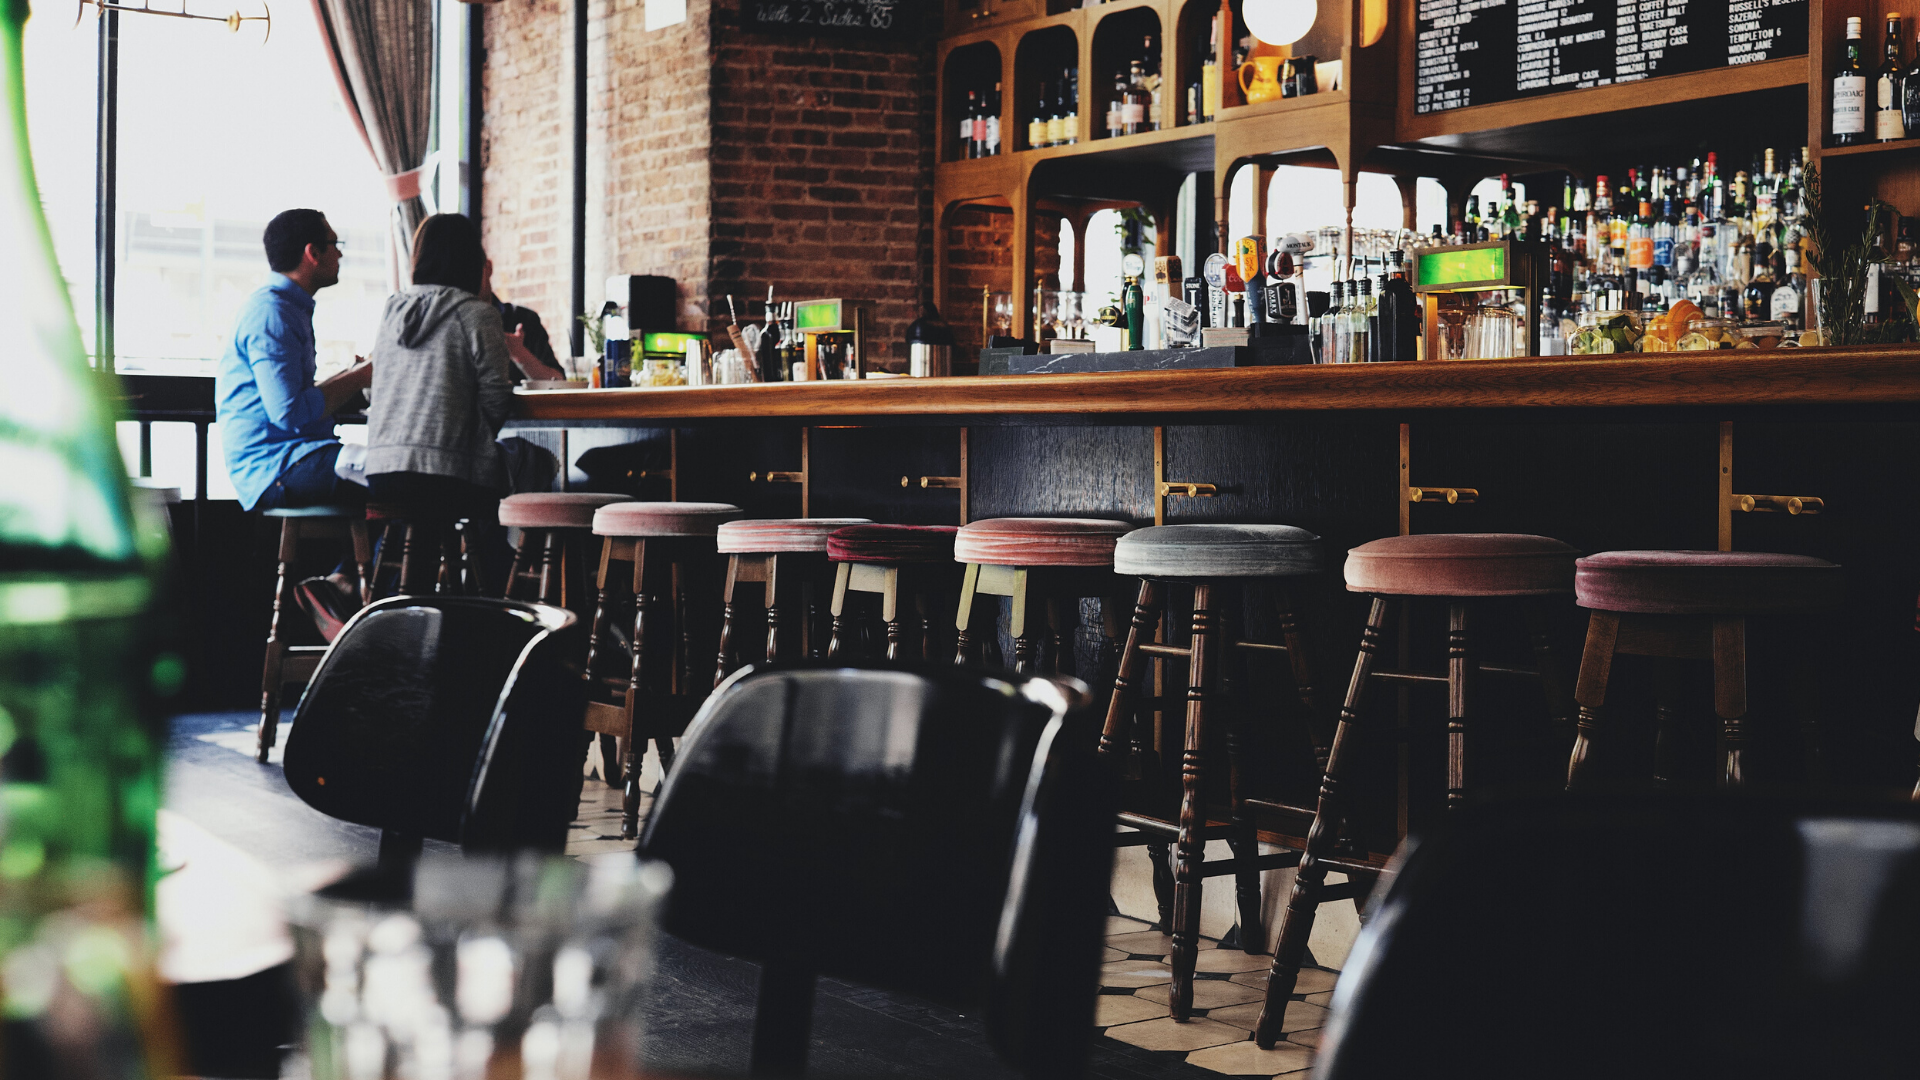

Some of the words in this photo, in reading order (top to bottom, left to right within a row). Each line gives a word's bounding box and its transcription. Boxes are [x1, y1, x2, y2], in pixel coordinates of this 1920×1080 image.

[1639, 0, 1665, 12] COFFEY
[1729, 0, 1769, 13] RUSSELL'S
[798, 4, 813, 23] 2
[819, 2, 865, 26] Sides
[1639, 9, 1665, 22] COFFEY
[1667, 6, 1686, 17] MALT
[1729, 9, 1763, 23] SAZERAC
[1669, 25, 1688, 37] CASK
[1729, 20, 1760, 34] SONOMA
[1669, 35, 1688, 46] CASK
[1729, 28, 1774, 44] TEMPLETON
[1776, 27, 1782, 37] 6
[1728, 42, 1752, 54] WIDOW
[1754, 39, 1773, 51] JANE
[1616, 52, 1646, 65] SUNTORY
[1728, 51, 1767, 65] WOODFORD
[1649, 60, 1657, 70] 12
[1582, 70, 1599, 80] CASK
[1286, 241, 1312, 249] MONTAUK
